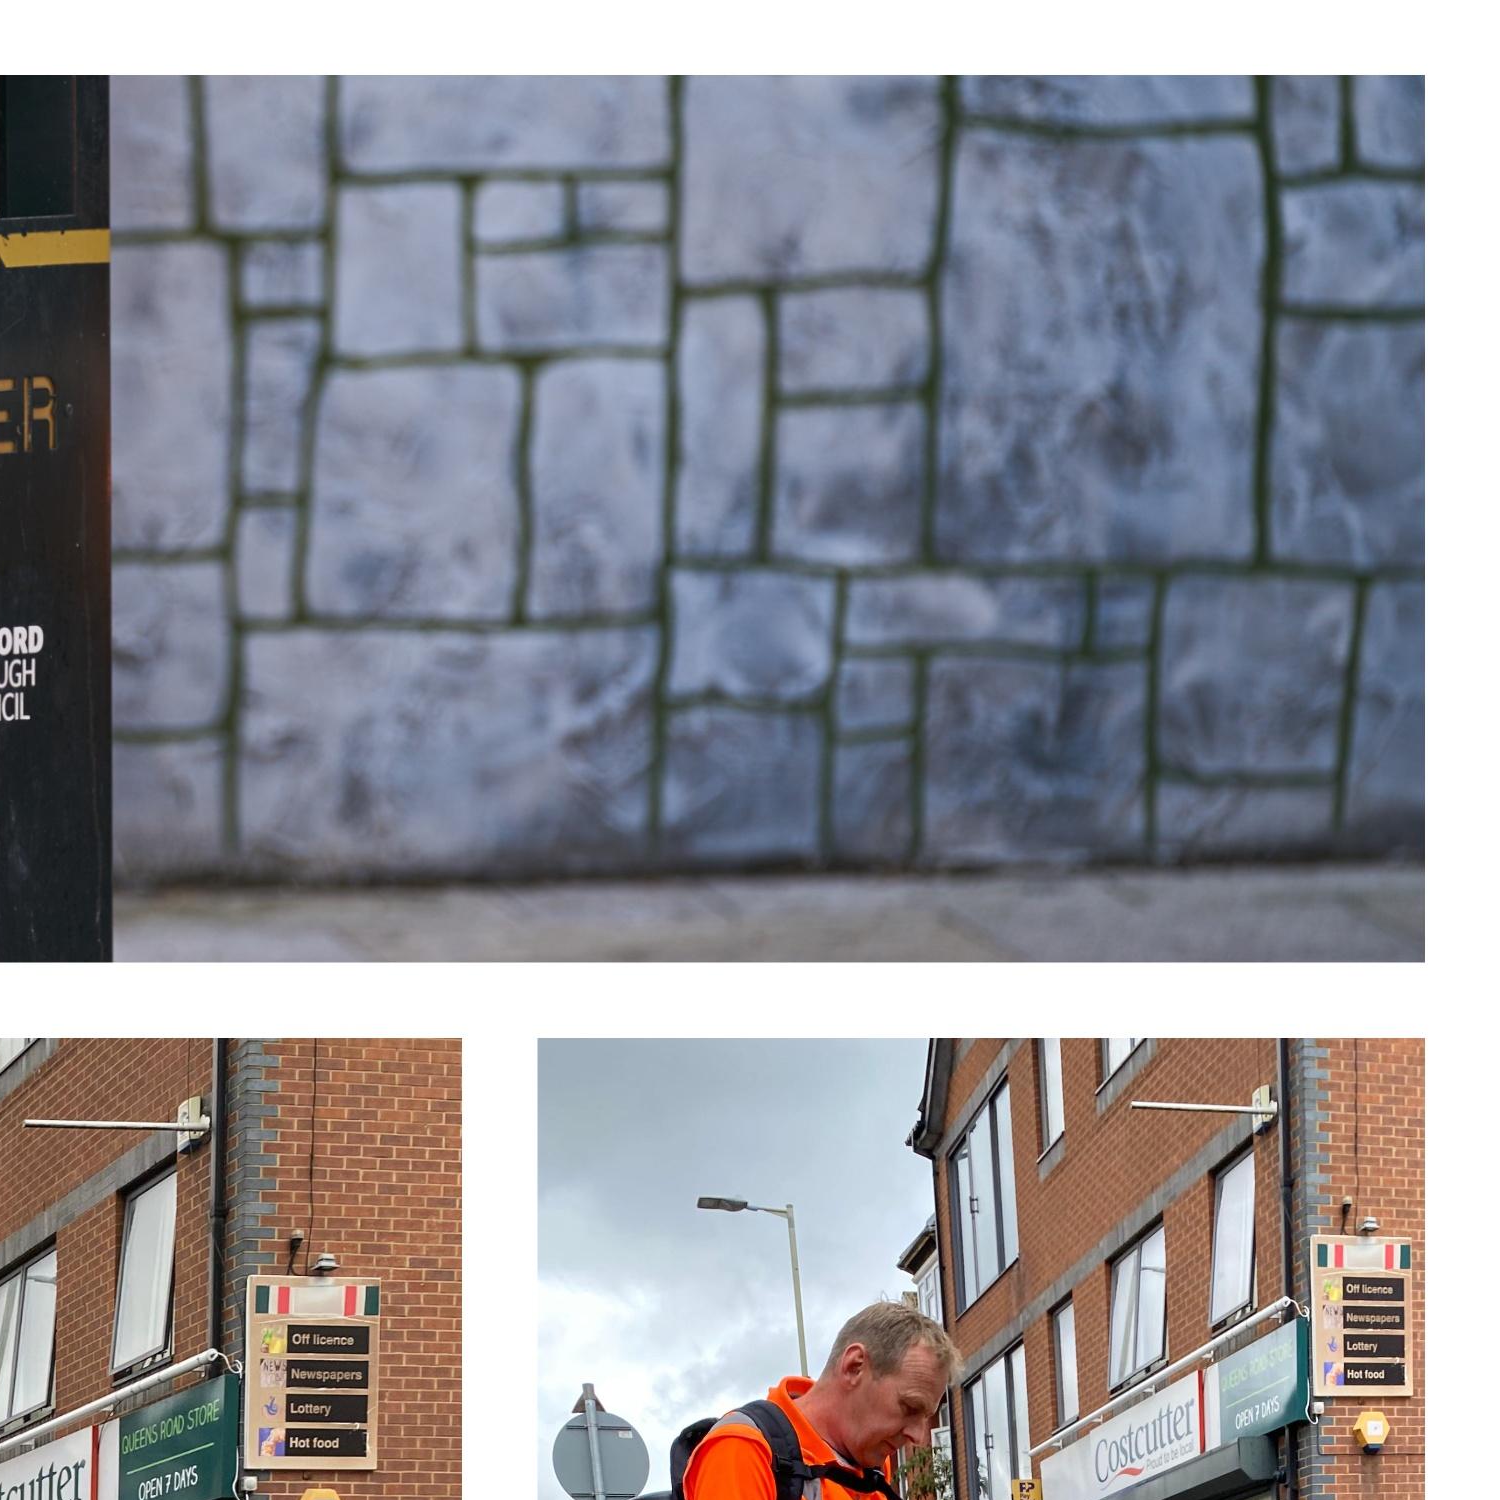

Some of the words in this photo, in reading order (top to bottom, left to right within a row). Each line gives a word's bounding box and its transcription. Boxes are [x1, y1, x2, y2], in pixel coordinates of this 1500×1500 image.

[1346, 1284, 1360, 1293] Off
[1362, 1284, 1393, 1294] licence
[1346, 1312, 1400, 1324] Newspapers
[292, 1334, 310, 1345] Off
[313, 1334, 355, 1345] licence
[1346, 1341, 1378, 1352] Lottery
[1221, 1366, 1250, 1392] QUEENS
[1268, 1339, 1293, 1366] STORE
[291, 1368, 363, 1382] Newspapers
[1347, 1369, 1363, 1379] Hot
[1365, 1369, 1385, 1379] food
[290, 1402, 331, 1416] Lottery
[1235, 1410, 1253, 1430] OPEN
[1255, 1407, 1260, 1420] 7
[1261, 1396, 1280, 1418] DAYS
[122, 1424, 158, 1455] QUEENS
[160, 1414, 184, 1440] ROAD
[187, 1405, 220, 1430] STORE
[289, 1437, 310, 1448] Hot
[313, 1437, 340, 1448] food
[1095, 1398, 1194, 1483] Costcutter
[1146, 1453, 1161, 1470] Proud
[1161, 1450, 1169, 1464] to
[1170, 1447, 1179, 1461] be
[1179, 1440, 1194, 1458] local
[165, 1477, 171, 1494] 7
[173, 1465, 198, 1492] DAYS
